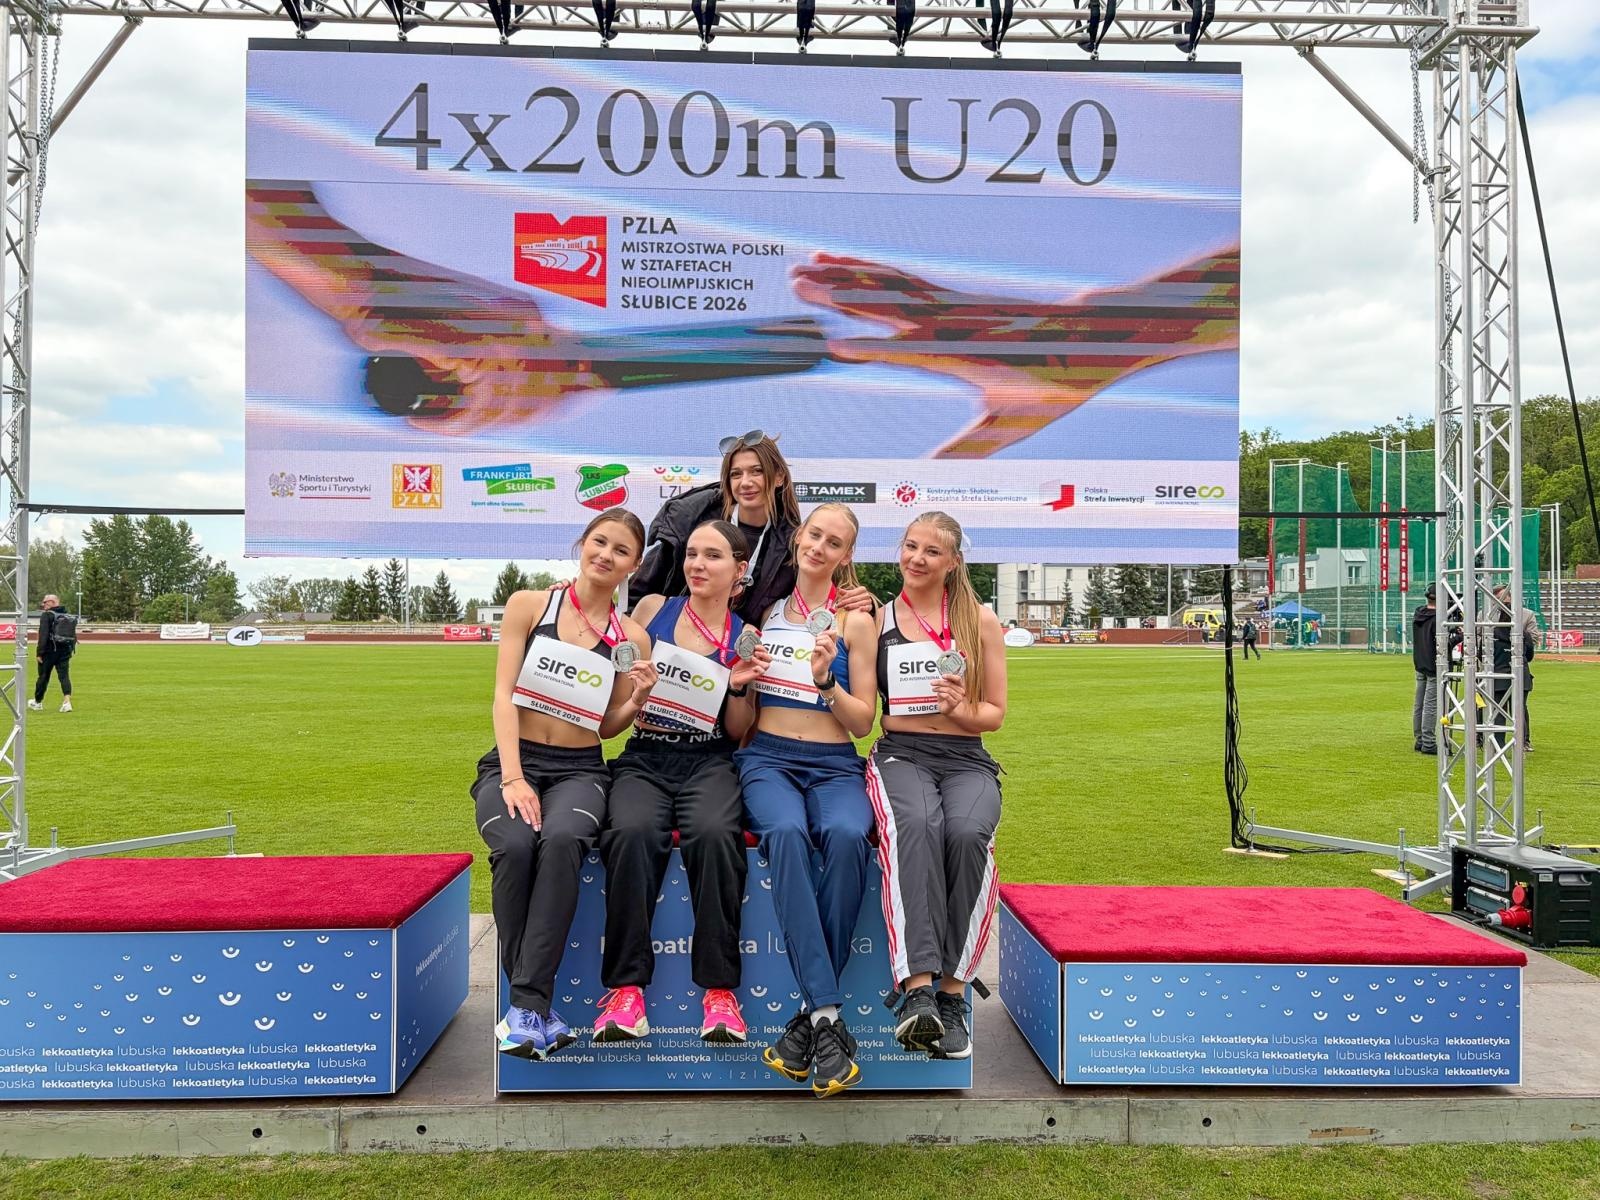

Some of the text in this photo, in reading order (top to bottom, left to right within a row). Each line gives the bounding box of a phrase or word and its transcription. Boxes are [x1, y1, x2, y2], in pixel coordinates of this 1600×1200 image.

[374, 82, 1118, 186] 4x200m U20
[622, 216, 678, 235] PZLA
[621, 241, 784, 256] MISTRZOSTWA POLSKI
[621, 258, 732, 272] W SZTAFETACH
[621, 276, 754, 291] NIEOLIMPIJSKICH
[621, 294, 747, 311] SŁUBICE 2026
[299, 474, 354, 482] Ministerstwo
[470, 471, 532, 480] FRANKFURT
[299, 484, 327, 493] Sportu
[333, 484, 371, 493] Turystyki
[809, 486, 866, 496] TAMEX
[1108, 495, 1145, 504] Inwestycji
[451, 627, 481, 636] PZLA
[900, 660, 937, 675] sire
[755, 683, 781, 694] SŁUBICE
[782, 689, 800, 698] 2026
[530, 700, 561, 715] SŁUBICE
[562, 711, 581, 723] 2026
[649, 705, 678, 718] SŁUBICE
[679, 714, 696, 725] 2026
[908, 704, 938, 713] SŁUBICE
[650, 1025, 700, 1036] ekkoatlety
[588, 1040, 652, 1050] lekkoatletyka
[658, 1038, 702, 1049] lubuska
[1079, 1032, 1511, 1046] lekkoatletyka lubuska lekkoatletyka lubuska lekkoatletyka lubuska lekkoatletyka
[42, 1047, 114, 1058] lekkoatletyka
[117, 1045, 166, 1056] lubuska
[173, 1046, 245, 1056] lekkoatletyka
[249, 1043, 298, 1054] lubuska
[305, 1043, 377, 1054] lekkoatletyka
[597, 1052, 641, 1063] lubuska
[647, 1054, 711, 1063] lekkoatletyka
[714, 1052, 758, 1062] lubuska
[1090, 1047, 1501, 1061] lubuska lekkoatletyka lubuska lekkoatletyka lubuska lekkoatletyka lubuska
[55, 1062, 103, 1072] lubuska
[106, 1063, 178, 1073] lekkoatletyka
[185, 1060, 234, 1071] lubuska
[238, 1060, 310, 1071] lekkoatletyka
[317, 1057, 367, 1069] lubuska
[1078, 1063, 1510, 1077] lekkoatletyka lubuska lekkoatletyka lubuska lekkoatletyka lubuska lekkoatletyka
[42, 1079, 114, 1089] lekkoatletyka
[117, 1077, 166, 1088] lubuska
[172, 1078, 245, 1088] lekkoatletyka
[248, 1075, 298, 1086] lubuska
[304, 1075, 377, 1086] lekkoatletyka
